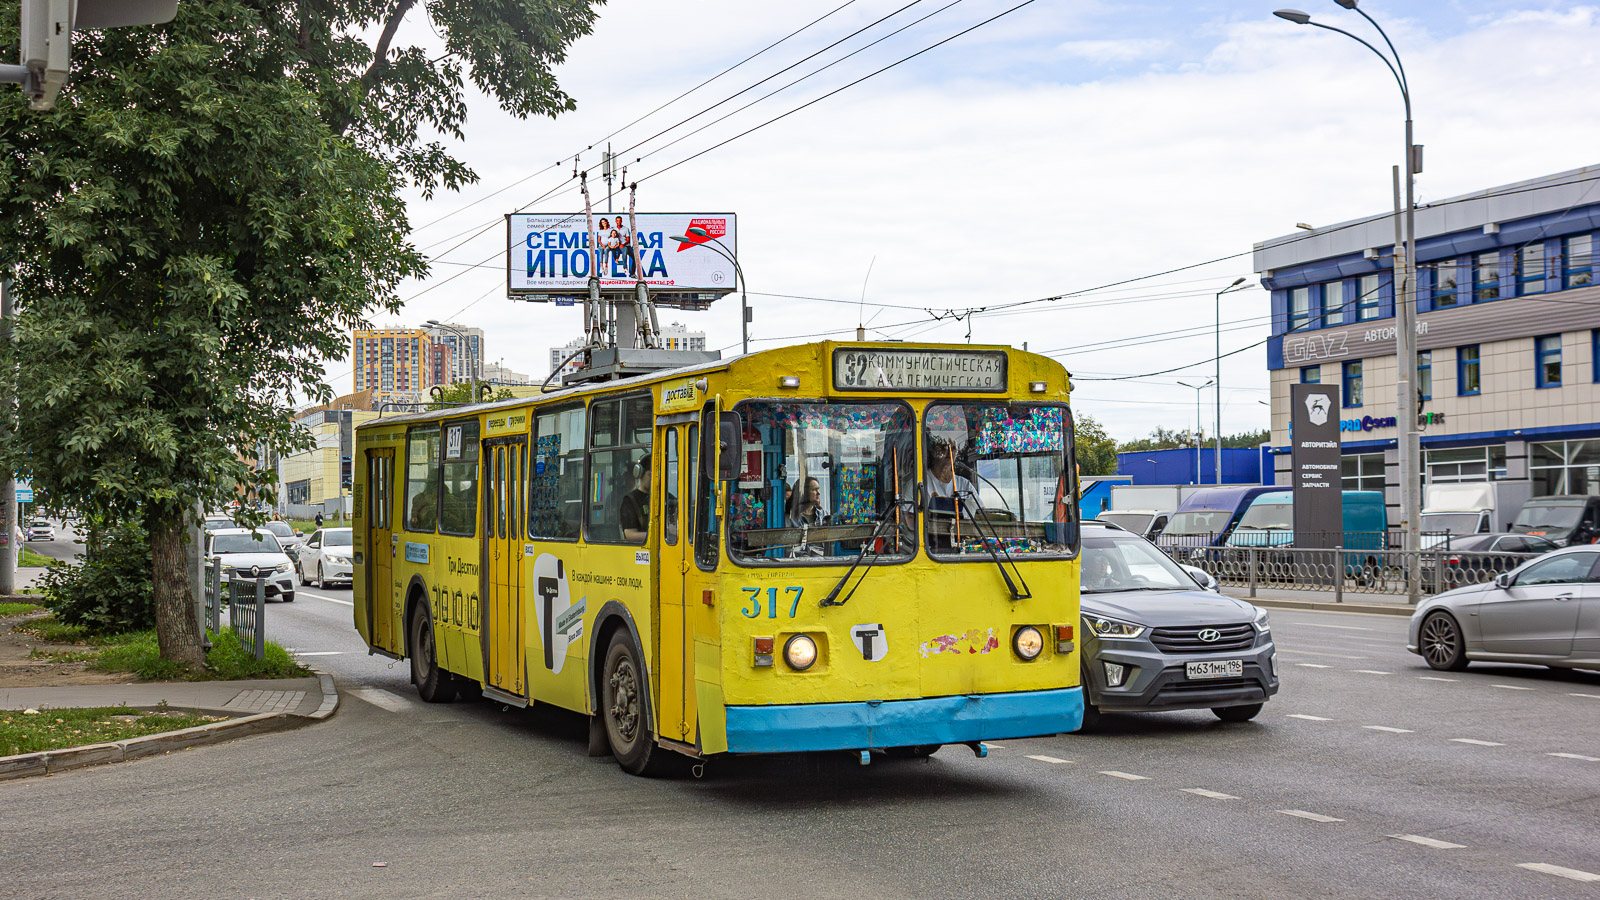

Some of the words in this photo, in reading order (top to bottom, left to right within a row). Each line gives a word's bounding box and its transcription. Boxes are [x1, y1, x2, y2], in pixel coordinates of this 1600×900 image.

[713, 273, 723, 282] 0+
[1286, 331, 1349, 362] GAZ
[845, 354, 868, 386] 32
[868, 354, 1001, 372] КОММУНИСТИЧЕСКАЯ
[877, 373, 992, 387] АКАДЕМИЧЕСКАЯ
[450, 428, 460, 448] 317
[1301, 440, 1338, 449] АВТОРИТЭЙЛ
[448, 556, 456, 575] Три
[457, 557, 479, 577] Десятки
[576, 572, 592, 586] каждой
[593, 574, 613, 586] машине
[616, 576, 628, 587] свои
[741, 586, 804, 619] 317
[1189, 663, 1226, 674] М631МН
[1227, 660, 1241, 669] 196
